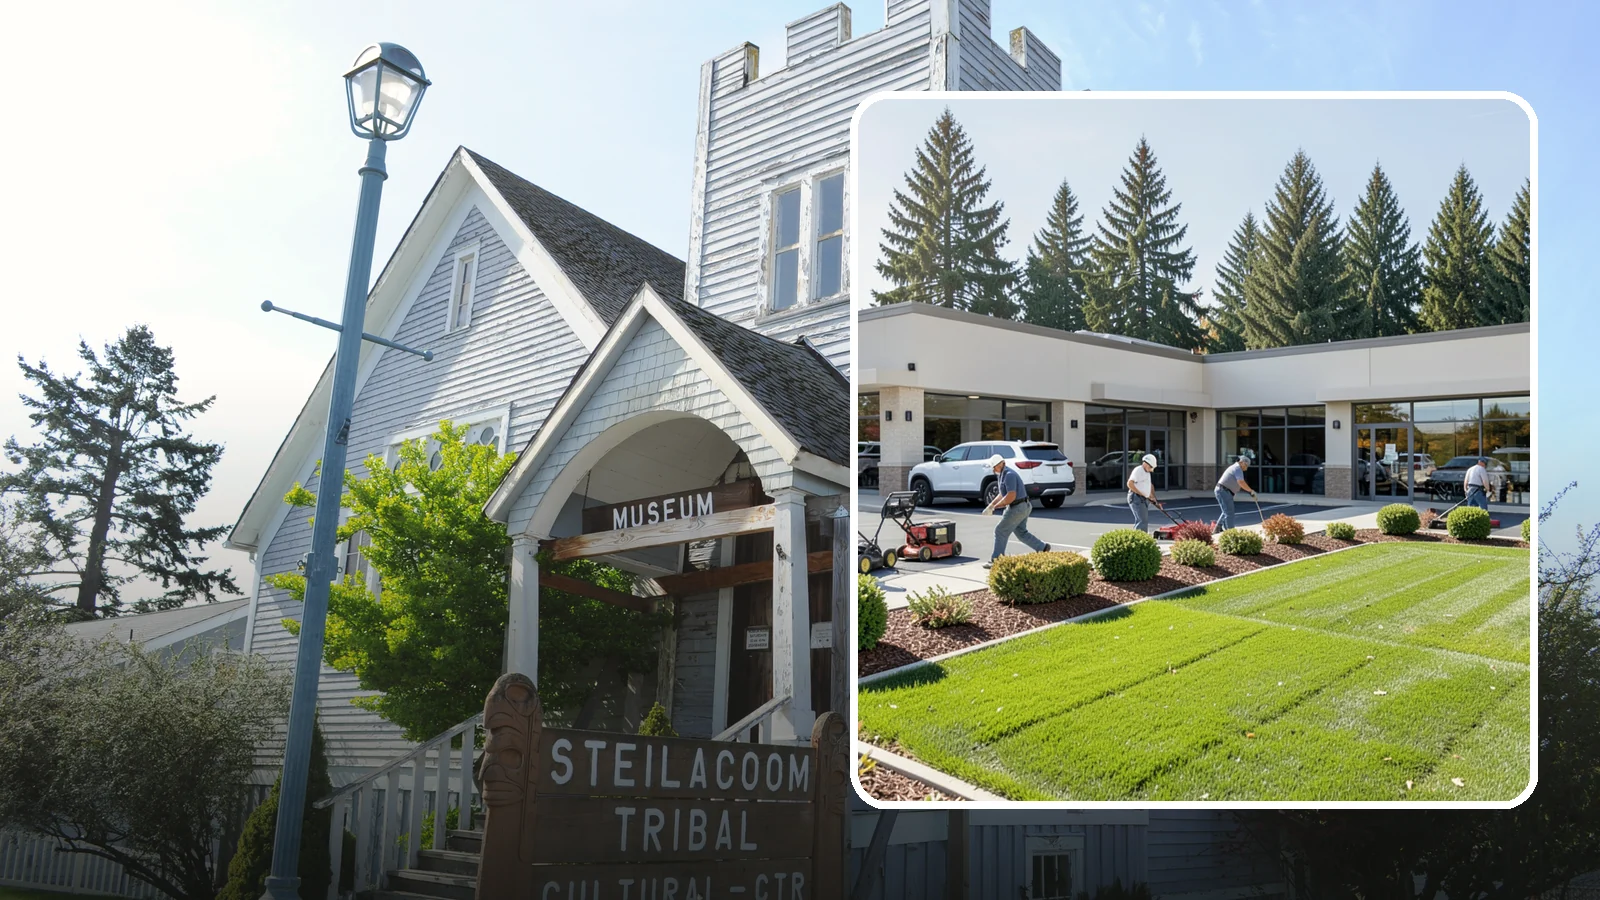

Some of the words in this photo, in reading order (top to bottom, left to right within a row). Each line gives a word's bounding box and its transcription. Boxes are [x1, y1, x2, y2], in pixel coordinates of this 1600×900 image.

[612, 491, 713, 531] MUSEUM
[550, 738, 809, 792] STEILACOOM
[615, 806, 757, 851] TRIBAL
